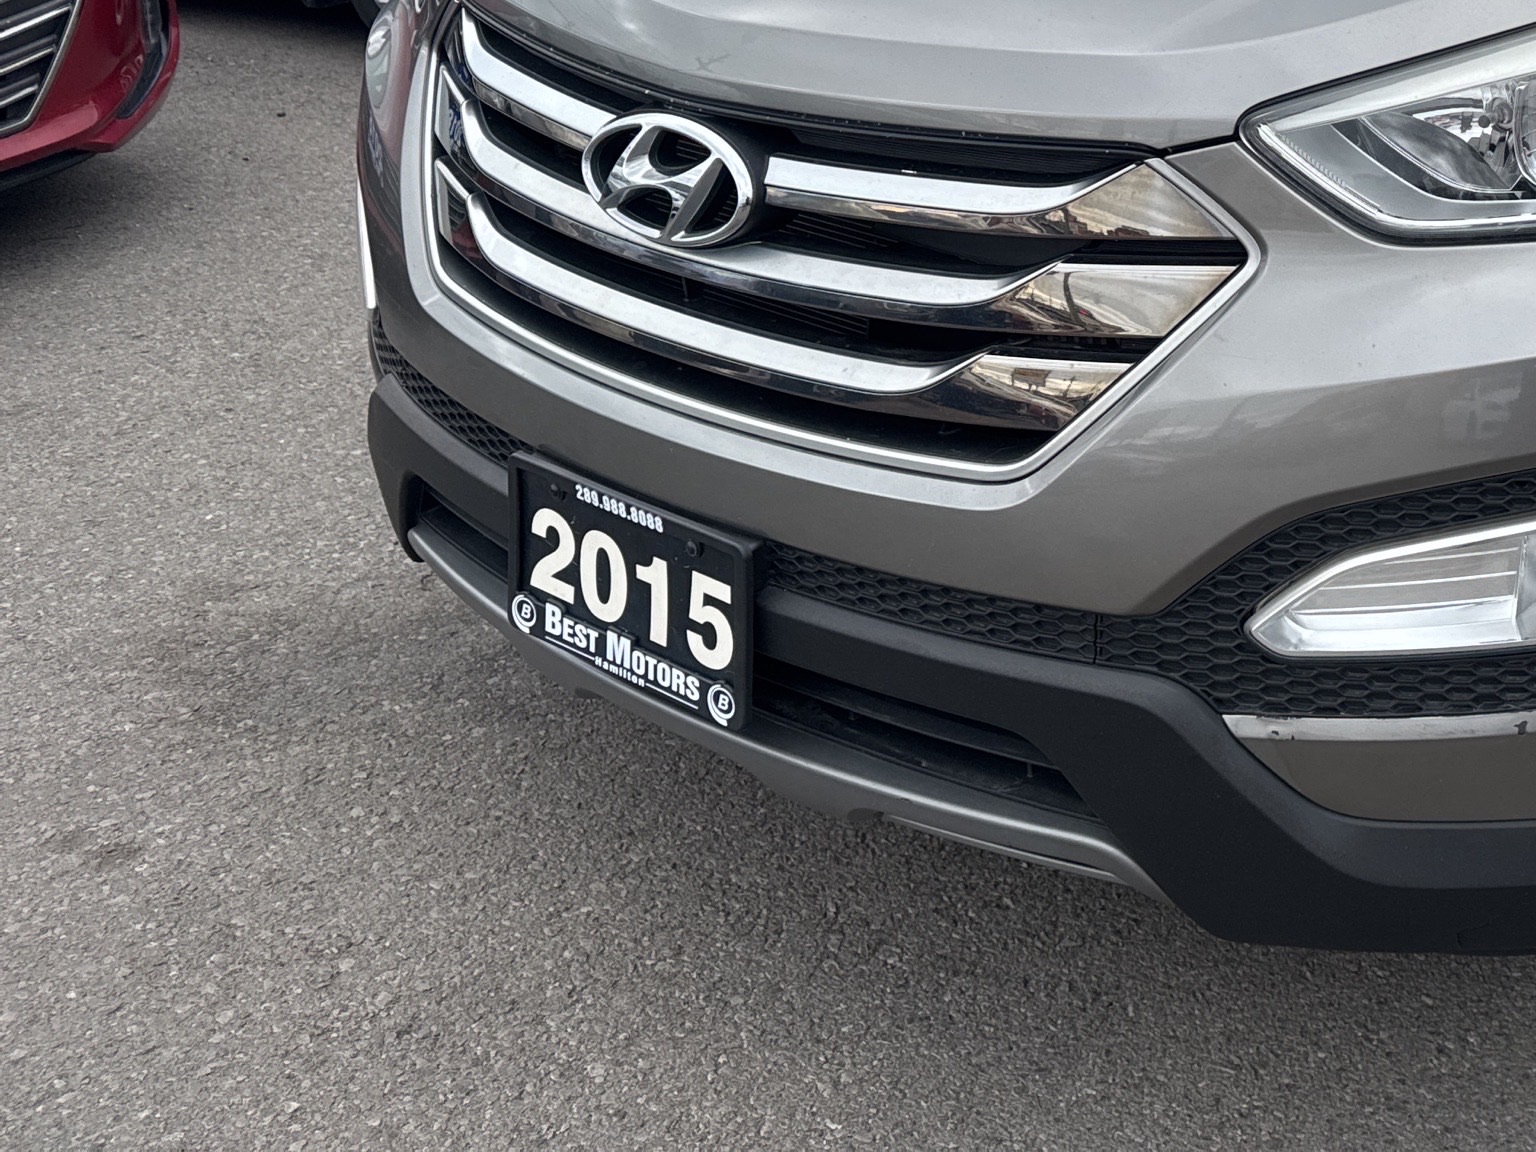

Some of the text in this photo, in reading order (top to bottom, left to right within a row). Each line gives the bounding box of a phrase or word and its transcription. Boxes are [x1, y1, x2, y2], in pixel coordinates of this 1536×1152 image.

[575, 484, 664, 534] 289.988.8088
[529, 507, 735, 671] 2015
[544, 602, 701, 701] BEST MOTORS
[594, 656, 646, 688] Hamilton
